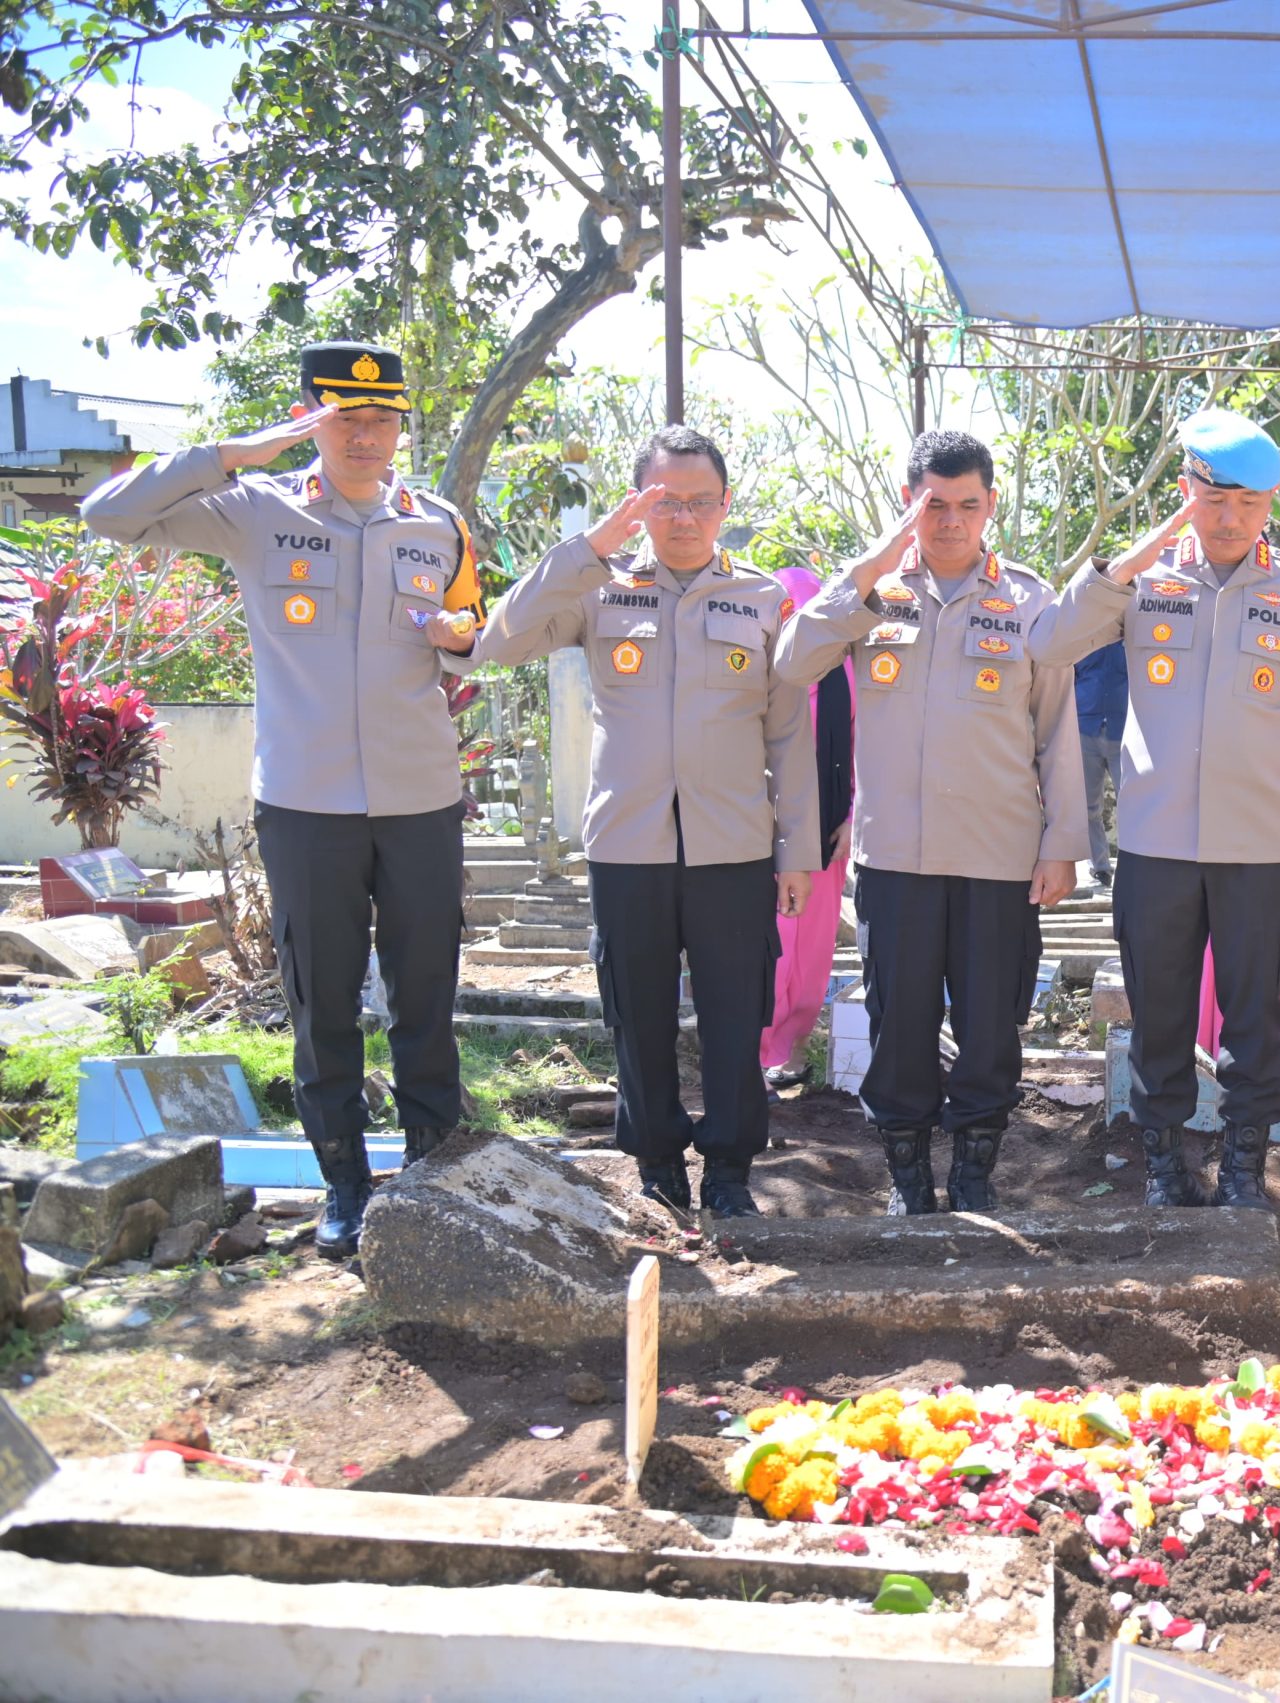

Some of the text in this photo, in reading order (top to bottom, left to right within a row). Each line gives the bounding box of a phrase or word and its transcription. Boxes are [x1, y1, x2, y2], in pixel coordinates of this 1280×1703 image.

[274, 534, 331, 552] YUGI
[397, 547, 442, 570] POLRI
[708, 600, 758, 619] POLRI
[1138, 598, 1193, 616] ADIWIJAYA
[970, 615, 1021, 634] POLRI
